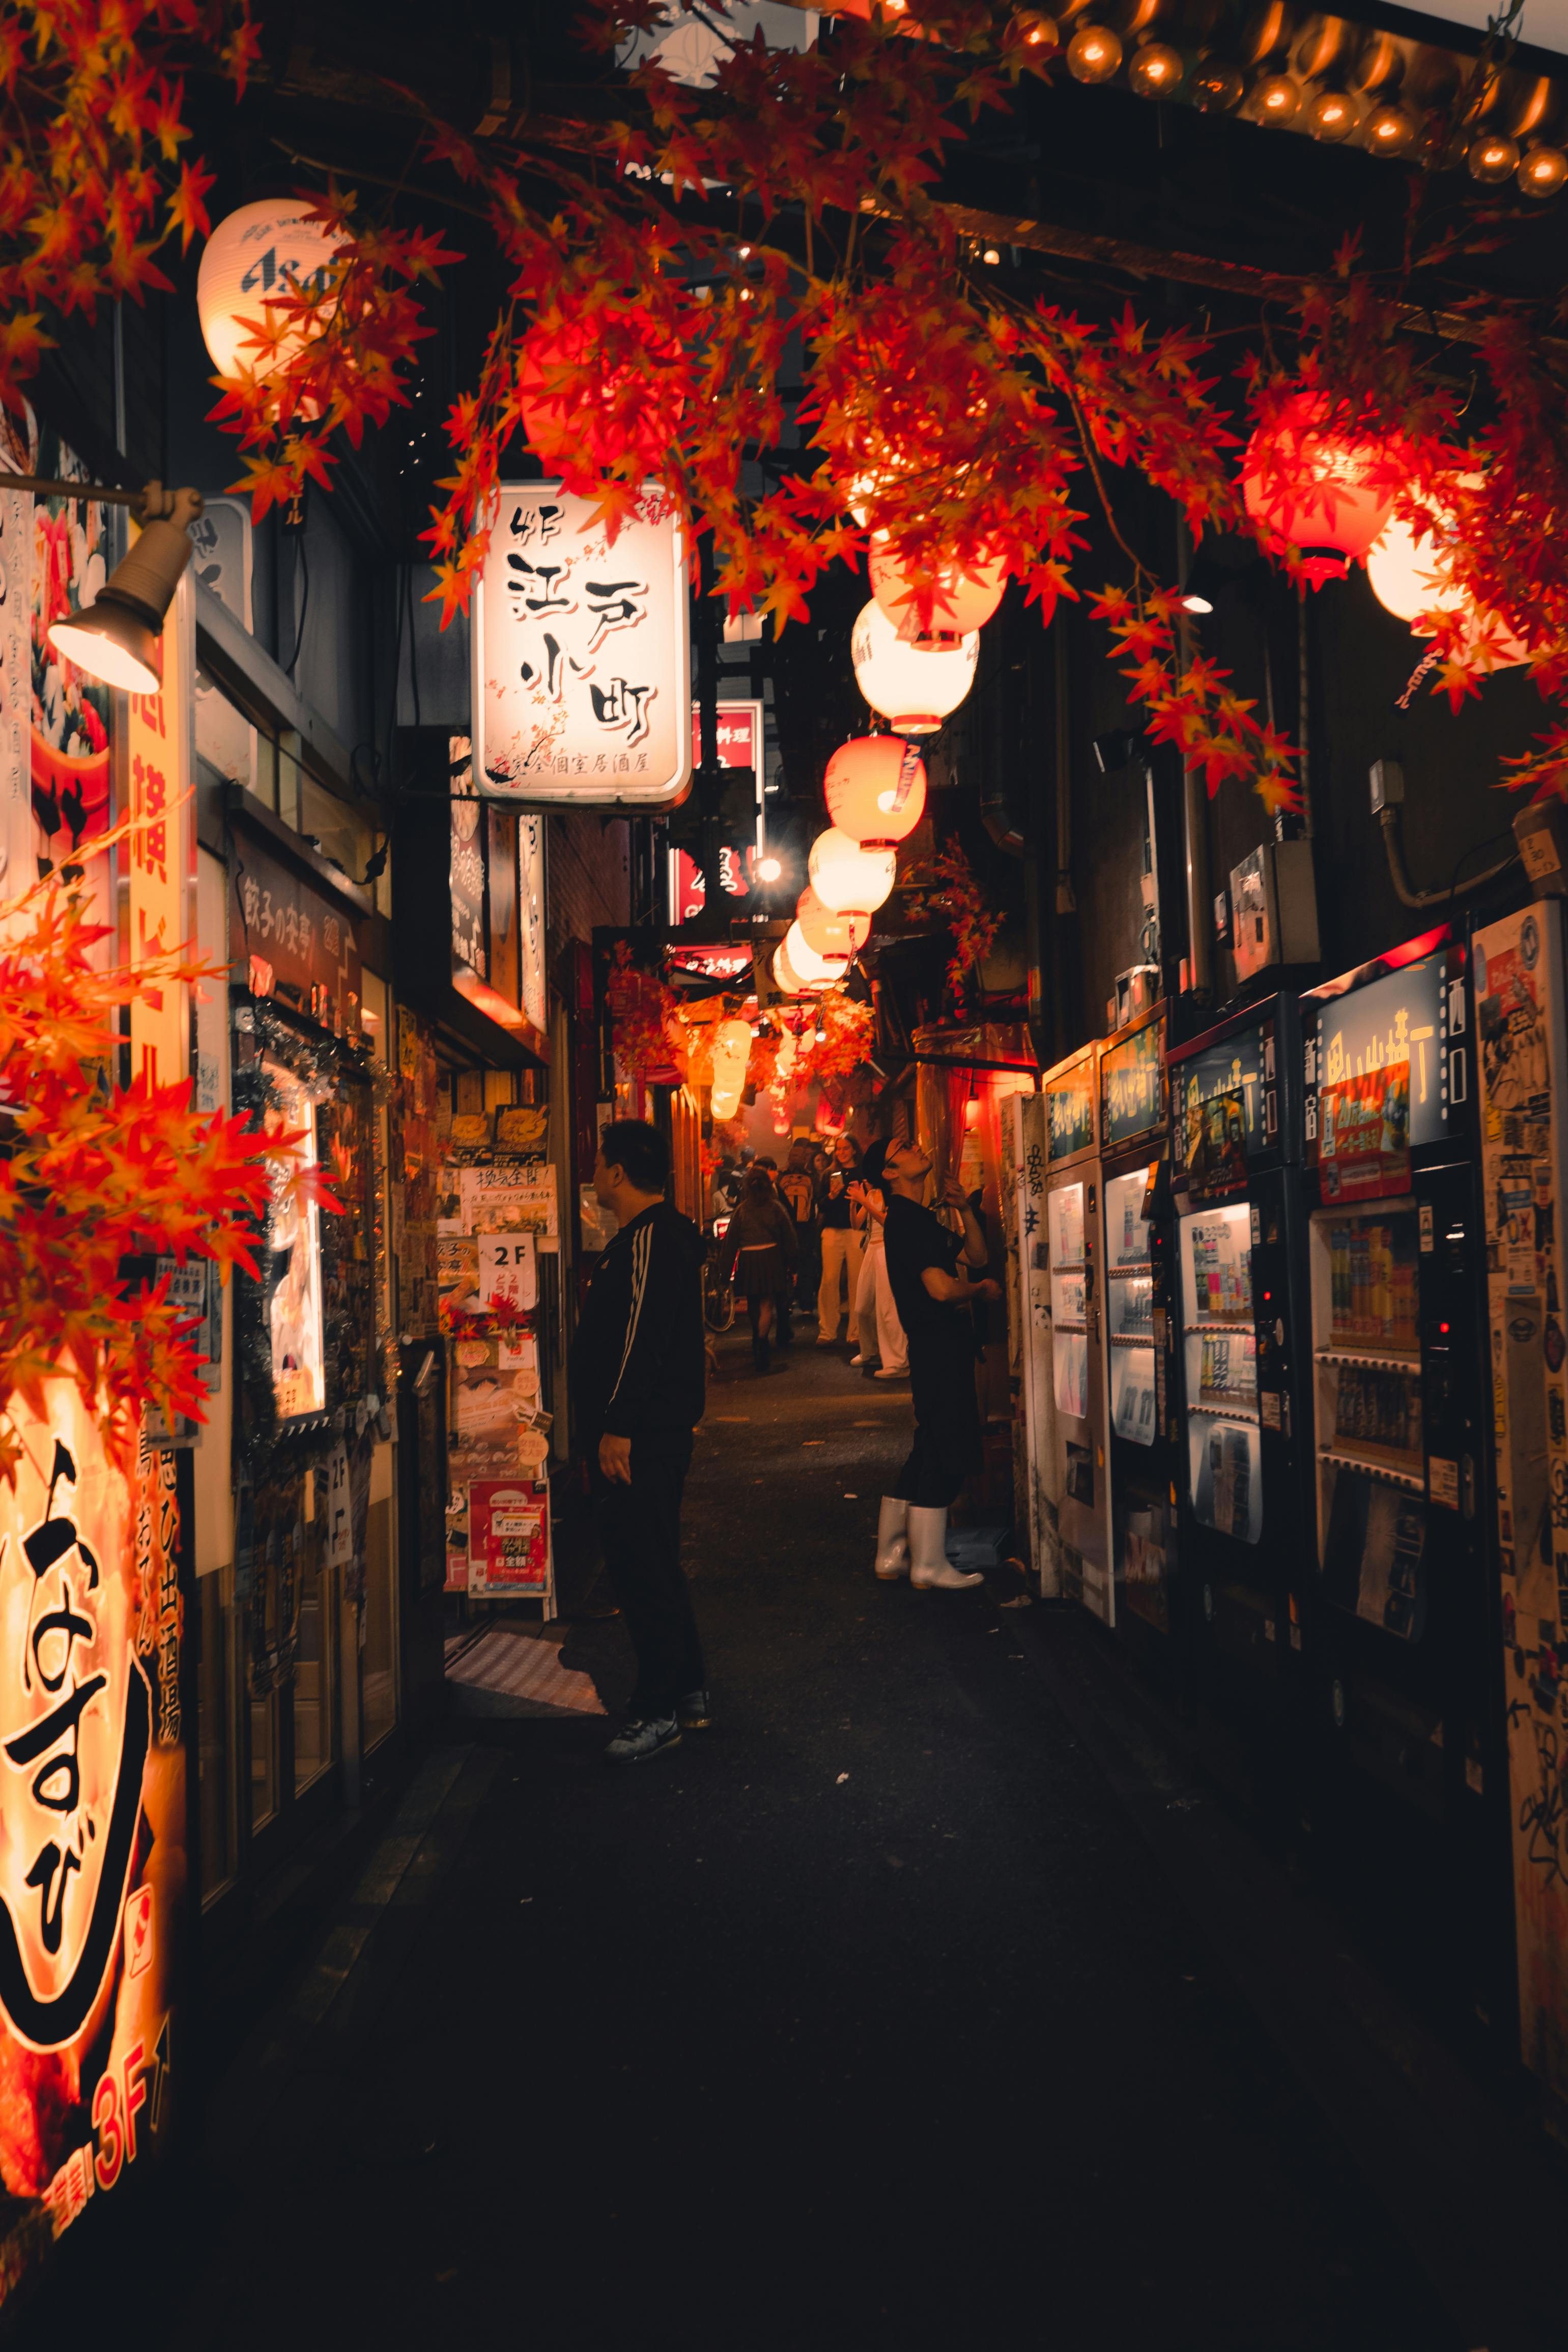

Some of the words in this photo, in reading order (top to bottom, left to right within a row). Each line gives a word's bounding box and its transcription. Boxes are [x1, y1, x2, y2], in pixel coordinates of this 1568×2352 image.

[241, 246, 340, 294] Asa
[507, 553, 650, 741] 江戸小町
[509, 753, 651, 775] 完全個室居酒屋
[495, 1245, 526, 1266] 2F
[92, 2041, 146, 2190] 3F
